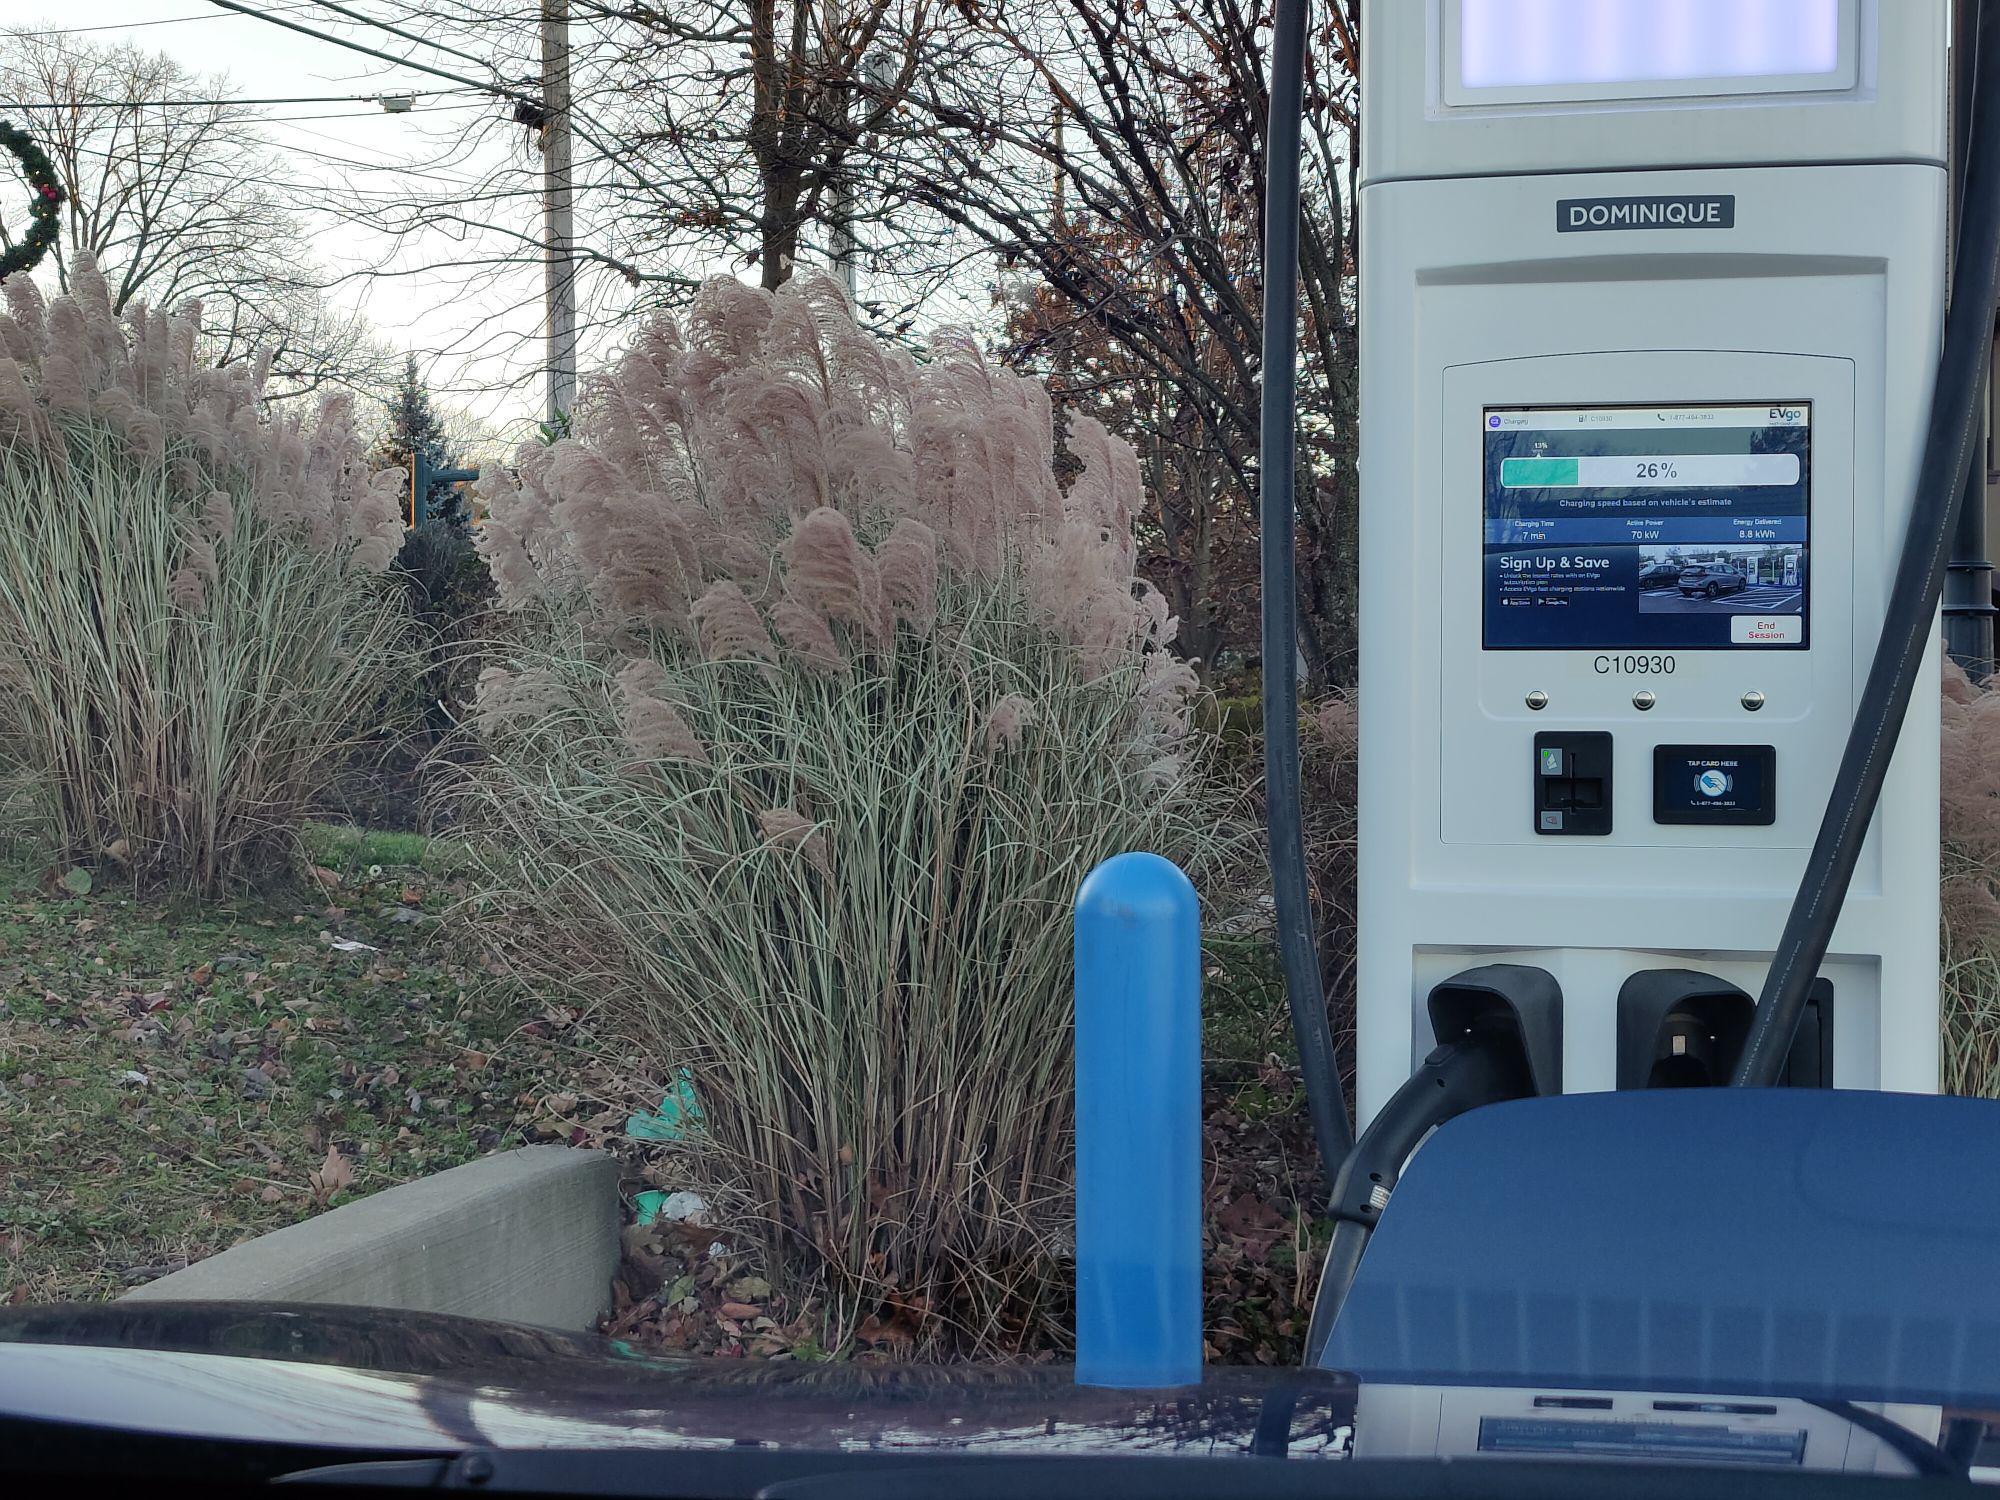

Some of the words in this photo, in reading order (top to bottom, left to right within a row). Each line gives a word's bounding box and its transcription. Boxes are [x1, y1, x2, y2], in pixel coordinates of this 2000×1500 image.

[1569, 202, 1721, 226] DOMINIQUE
[1769, 407, 1802, 422] EVgo
[1636, 462, 1677, 479] 26%
[1559, 499, 1596, 509] Charging
[1598, 499, 1621, 508] speed
[1622, 498, 1648, 507] based
[1649, 499, 1659, 507] on
[1660, 497, 1696, 507] vehicle's
[1697, 498, 1732, 506] estimate
[1733, 518, 1754, 526] Energy
[1522, 531, 1529, 541] 7
[1631, 530, 1643, 540] 70
[1644, 530, 1660, 540] kW
[1739, 530, 1753, 539] 8.8
[1755, 529, 1776, 539] kWh
[1500, 556, 1532, 571] Sign
[1535, 556, 1556, 571] Up
[1559, 556, 1571, 569] &
[1573, 556, 1610, 569] Save
[1757, 621, 1775, 631] End
[1748, 630, 1785, 640] Session
[1594, 654, 1676, 675] C10930
